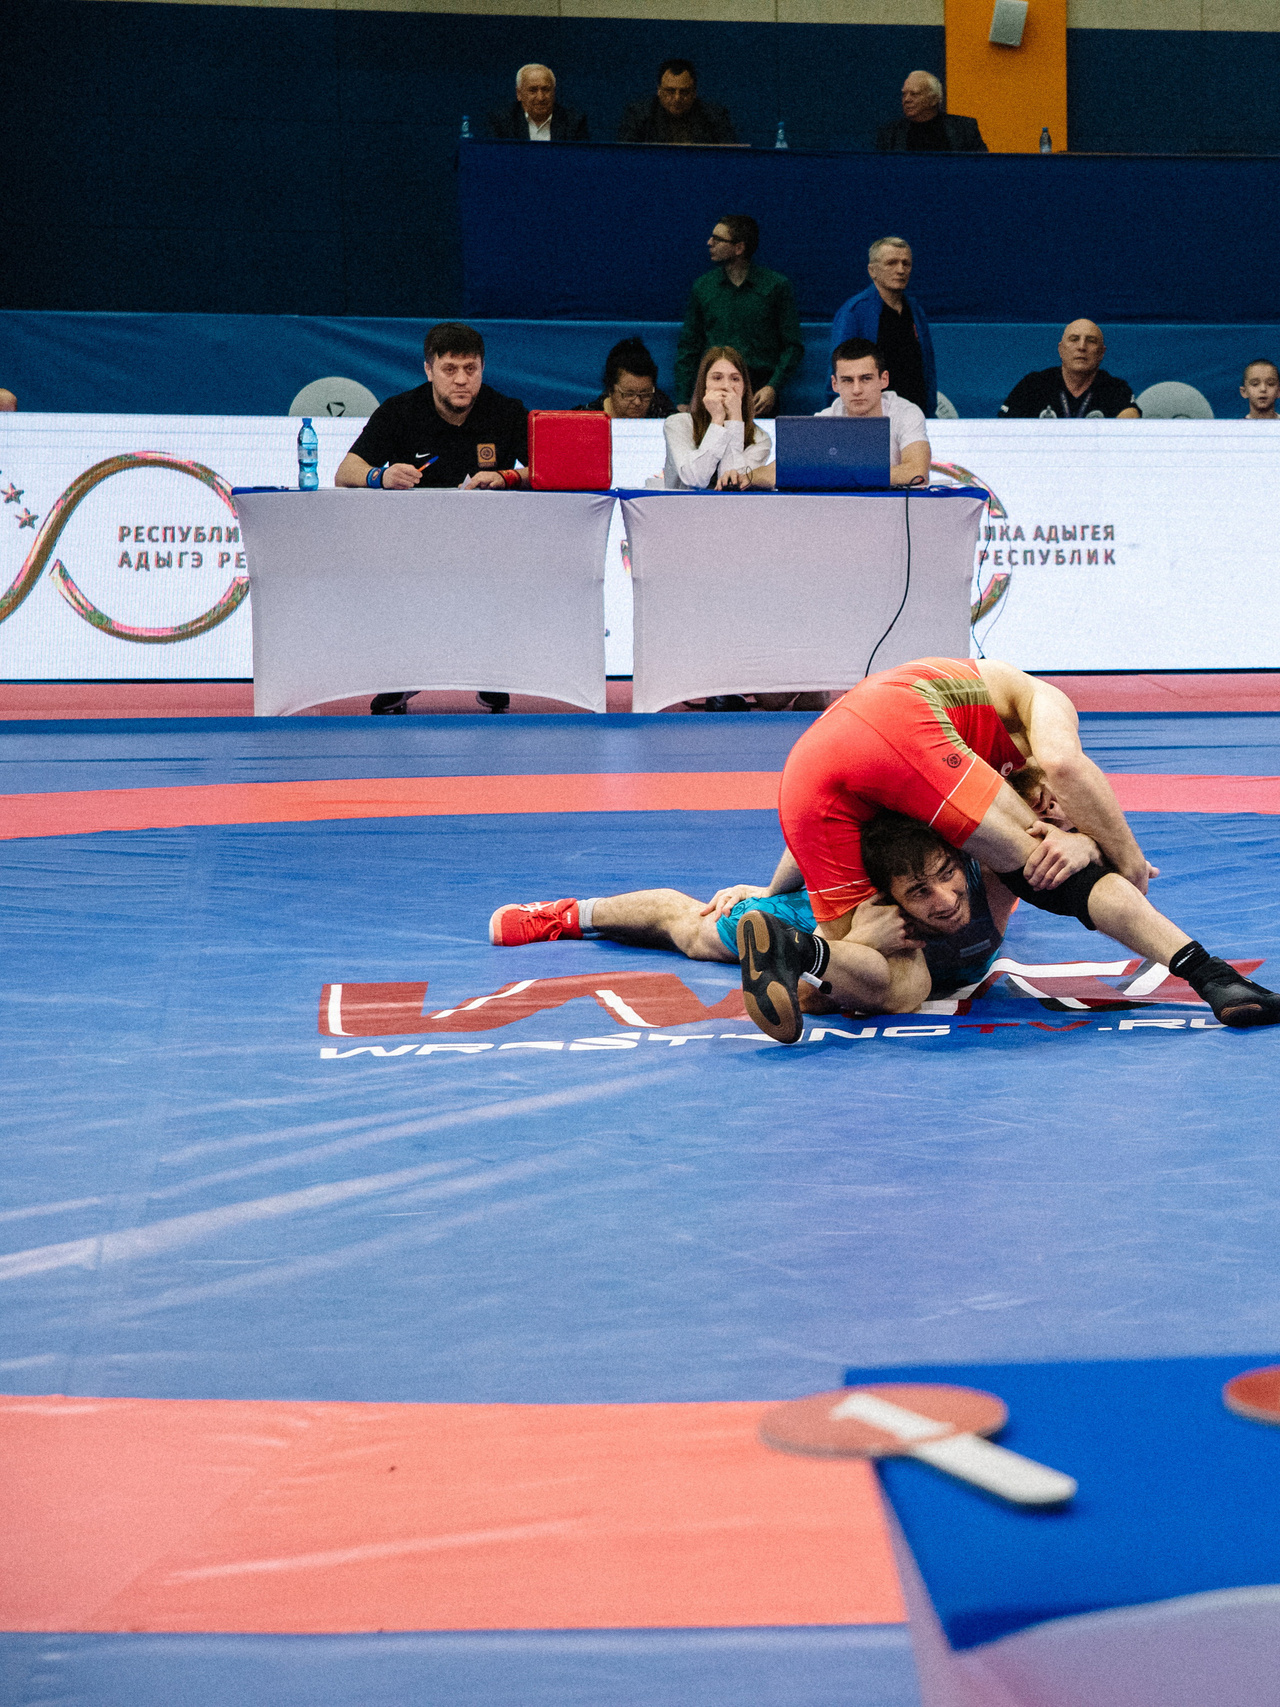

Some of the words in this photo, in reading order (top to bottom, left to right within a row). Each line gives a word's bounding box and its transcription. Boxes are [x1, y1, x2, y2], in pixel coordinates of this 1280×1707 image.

[118, 525, 240, 543] РЕСПУБЛИ
[1033, 525, 1115, 543] АДЫГЕЯ
[118, 551, 203, 571] АДЫГЭ
[979, 549, 1116, 566] РЕСПУБЛИК
[829, 1393, 956, 1440] 1
